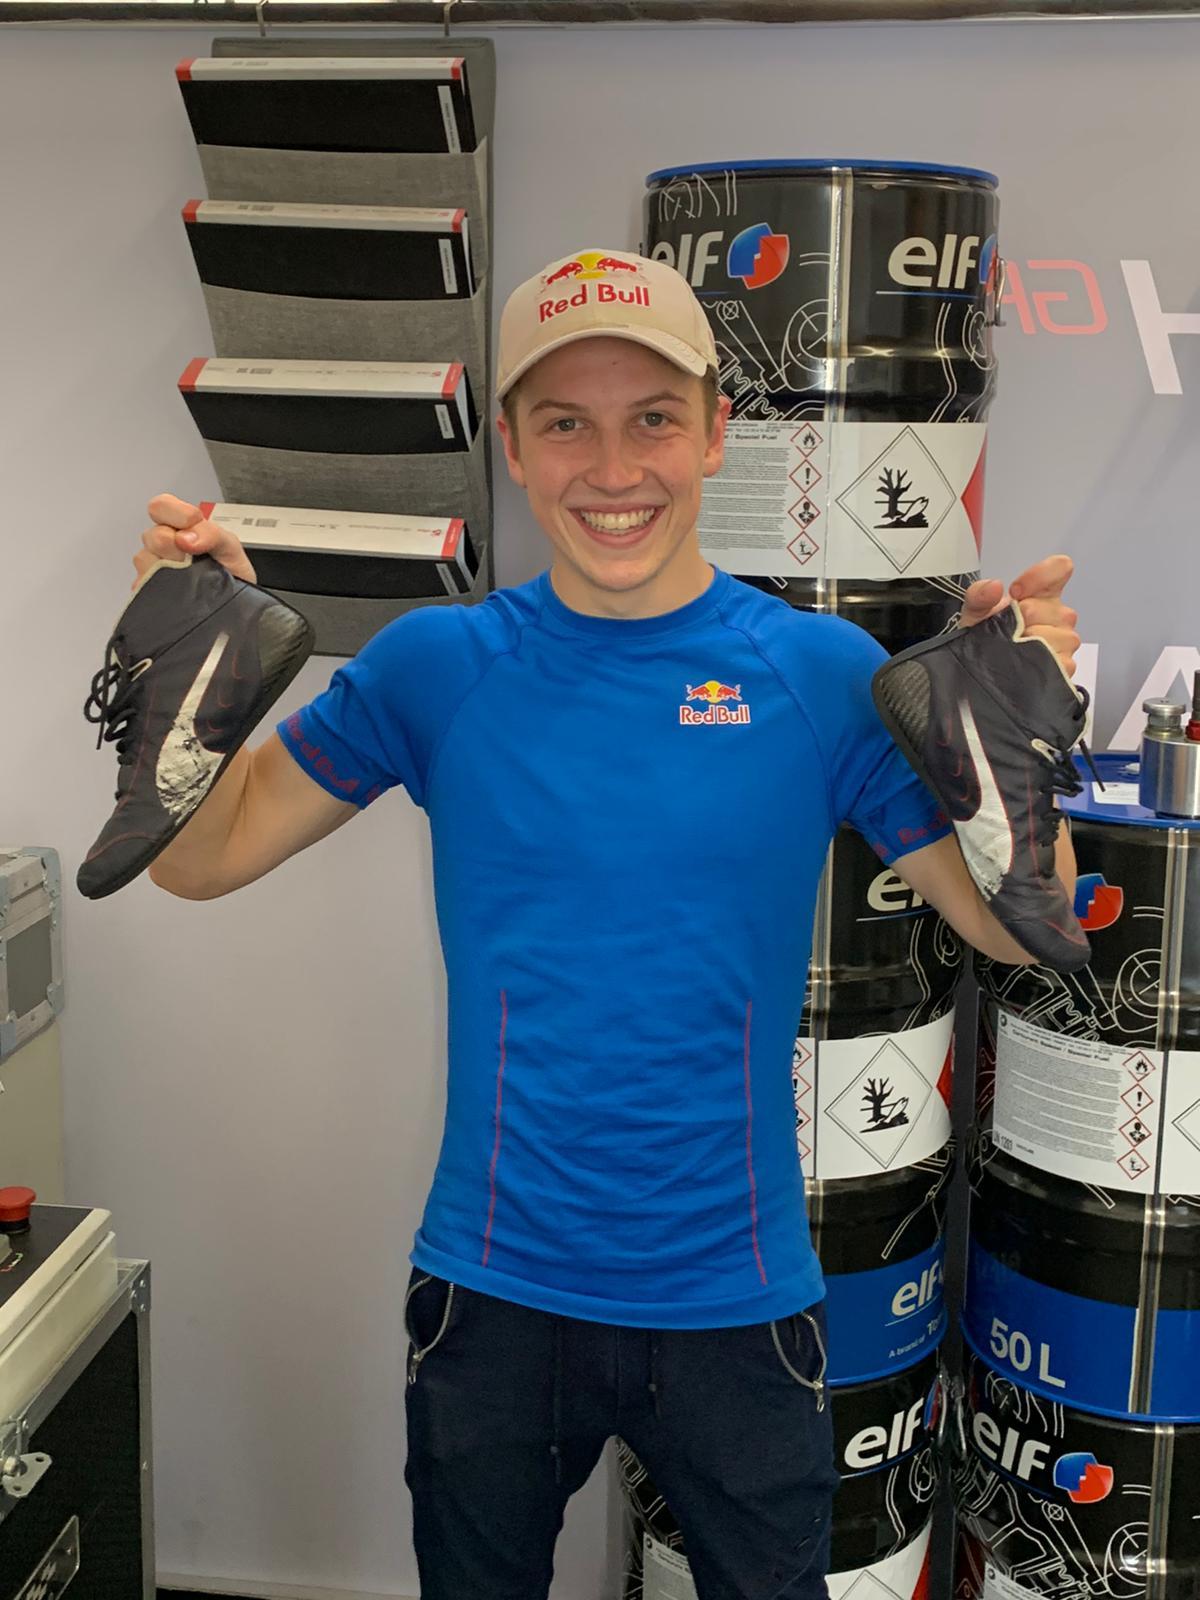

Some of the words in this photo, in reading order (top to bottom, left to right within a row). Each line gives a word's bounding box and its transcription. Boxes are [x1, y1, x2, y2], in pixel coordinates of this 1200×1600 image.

[888, 233, 980, 289] elf
[538, 283, 588, 323] Red
[597, 283, 650, 307] Bull
[680, 704, 715, 724] Red
[716, 704, 751, 724] Bull
[891, 1259, 939, 1316] elf
[989, 1317, 1032, 1372] 50
[1038, 1342, 1066, 1389] L
[844, 1397, 924, 1469] elf
[973, 1412, 1051, 1481] elf
